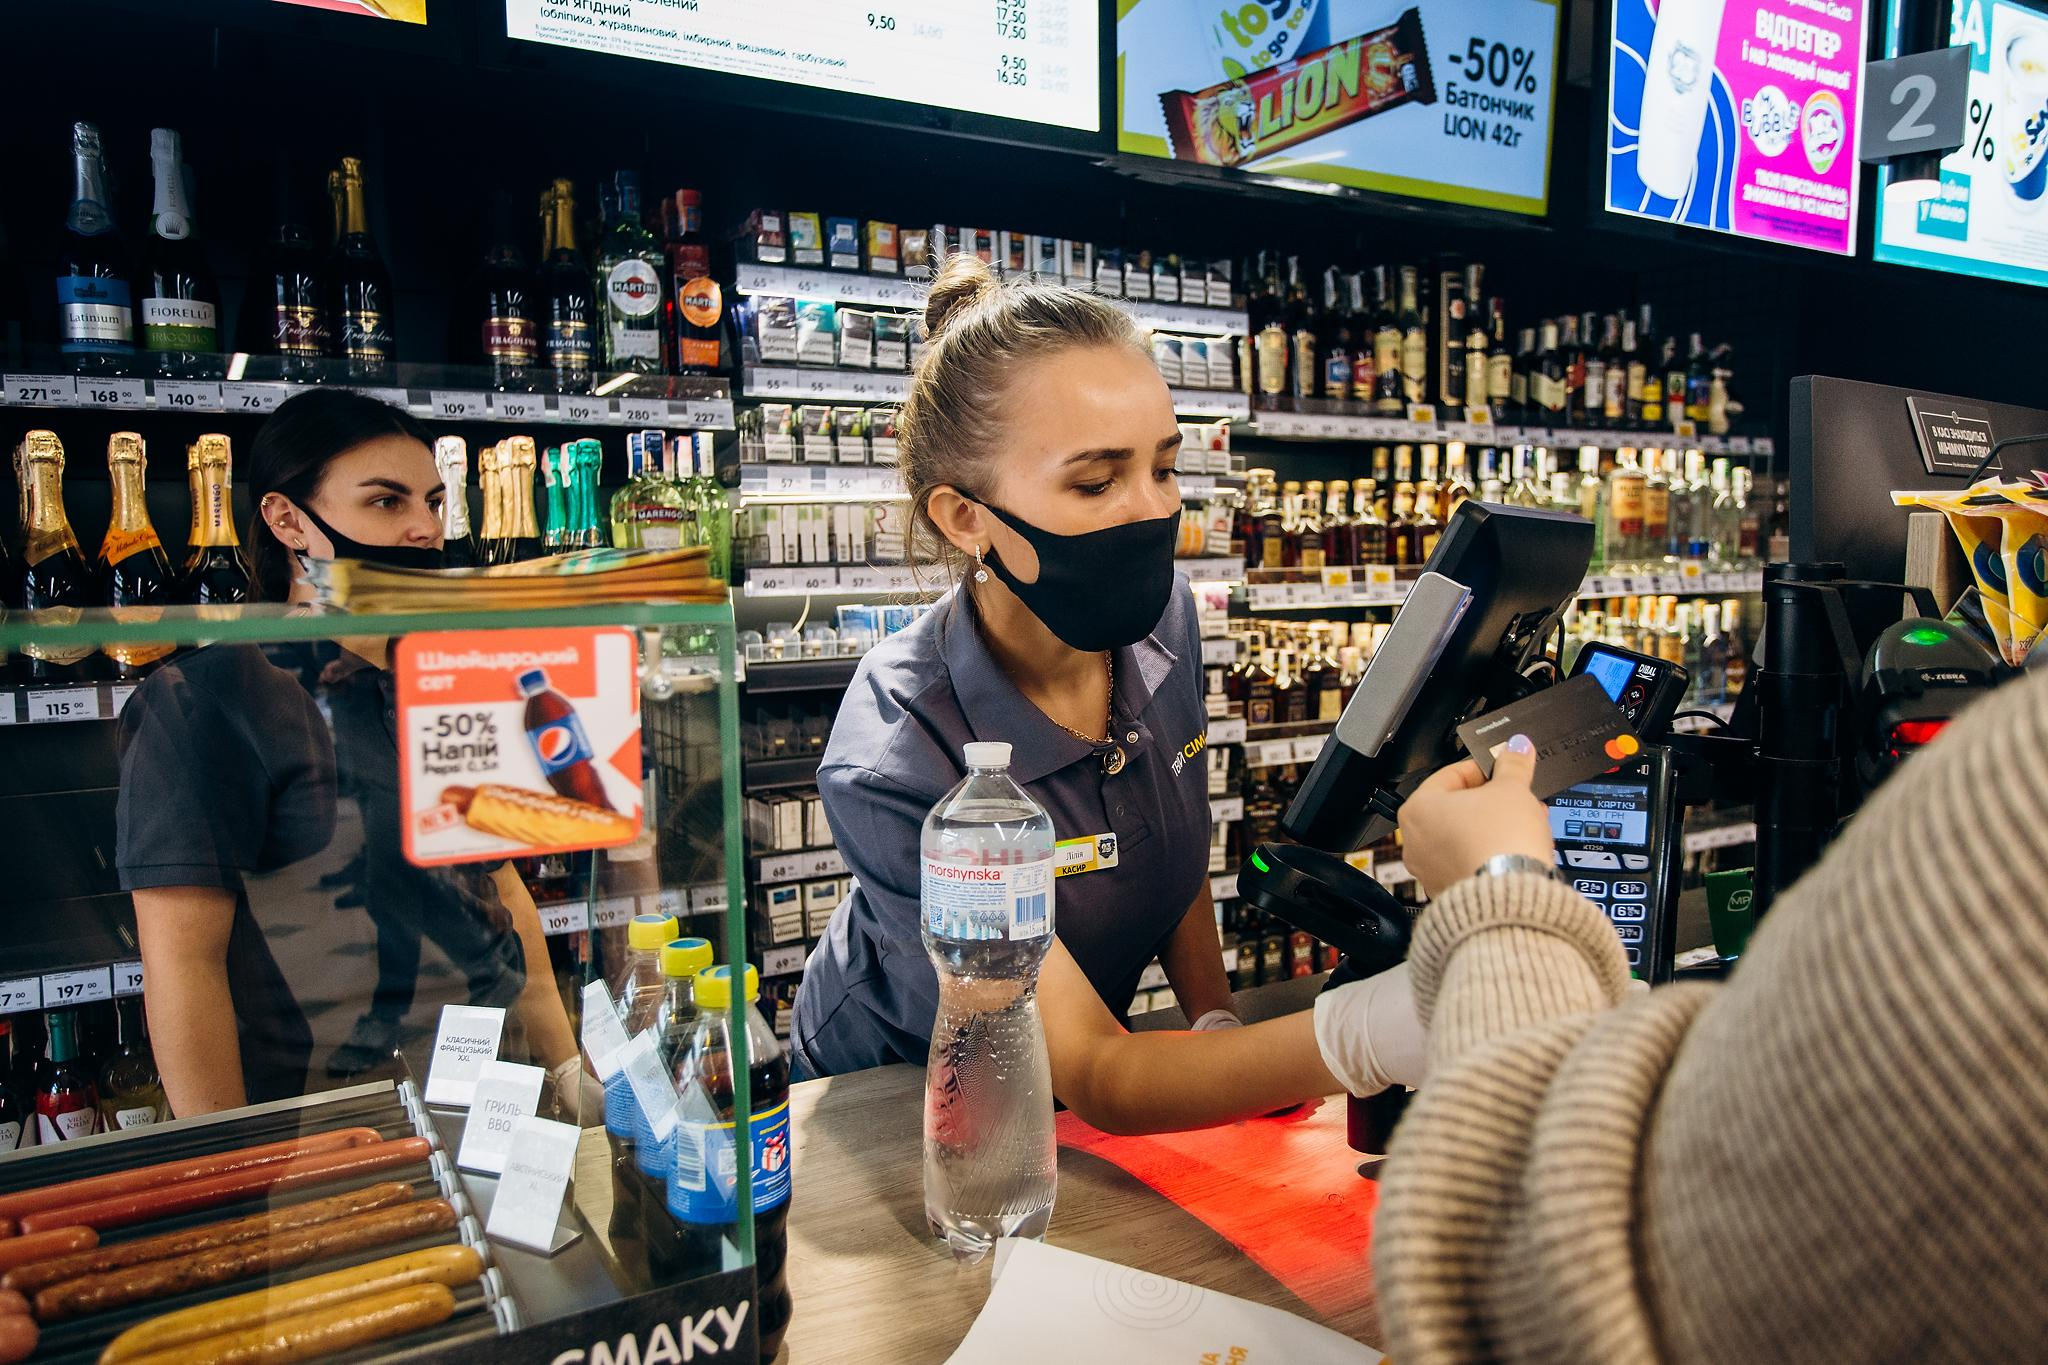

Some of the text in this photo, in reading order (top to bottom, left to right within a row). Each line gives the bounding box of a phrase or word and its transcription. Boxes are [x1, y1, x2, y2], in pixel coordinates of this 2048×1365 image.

[570, 0, 631, 17] ягідний
[867, 13, 896, 31] 9,50
[996, 6, 1026, 25] 17,50
[541, 8, 596, 27] (обліпиха,
[600, 18, 681, 42] журавлиновий,
[996, 22, 1027, 40] 17,50
[1755, 8, 1842, 60] ВІДТЕПЕР
[1001, 54, 1027, 71] 9,50
[1448, 37, 1537, 95] -50%
[996, 69, 1027, 86] 16,50
[1445, 82, 1535, 122] Батончик
[1887, 74, 1937, 142] 2
[1444, 113, 1522, 149] LION 42г
[612, 281, 658, 294] MARTINI
[753, 277, 767, 288] 65
[798, 280, 811, 291] 65
[841, 285, 854, 296] 65
[69, 313, 120, 324] Latinium
[151, 307, 208, 321] FIORELLI
[19, 388, 47, 401] 271
[90, 390, 118, 402] 168
[168, 393, 194, 406] 140
[241, 396, 260, 408] 76
[443, 403, 465, 414] 109
[504, 405, 525, 416] 109
[569, 407, 589, 418] 109
[627, 410, 650, 421] 280
[694, 412, 715, 423] 227
[211, 483, 222, 528] MARENGO
[638, 509, 684, 520] MARENGO
[763, 578, 777, 589] 60
[806, 577, 819, 588] 60
[1637, 663, 1657, 677] DIBAL
[1935, 673, 1966, 681] ZEBRA
[46, 703, 70, 716] 115
[422, 711, 498, 738] -50%
[422, 737, 499, 761] Напій
[1597, 801, 1636, 810] КАРТКУ
[1605, 811, 1625, 820] ГРН
[928, 863, 1001, 881] morshynska
[1062, 863, 1087, 875] КАСИР
[549, 918, 569, 929] 109
[595, 911, 615, 923] 109
[57, 983, 84, 1000] 197
[445, 1035, 491, 1047] КЛАСИЧНИЙ
[440, 1044, 492, 1056] ФРАНЦУЗЬКИЙ
[484, 1099, 522, 1117] ГРИЛЬ
[488, 1117, 512, 1133] BBQ
